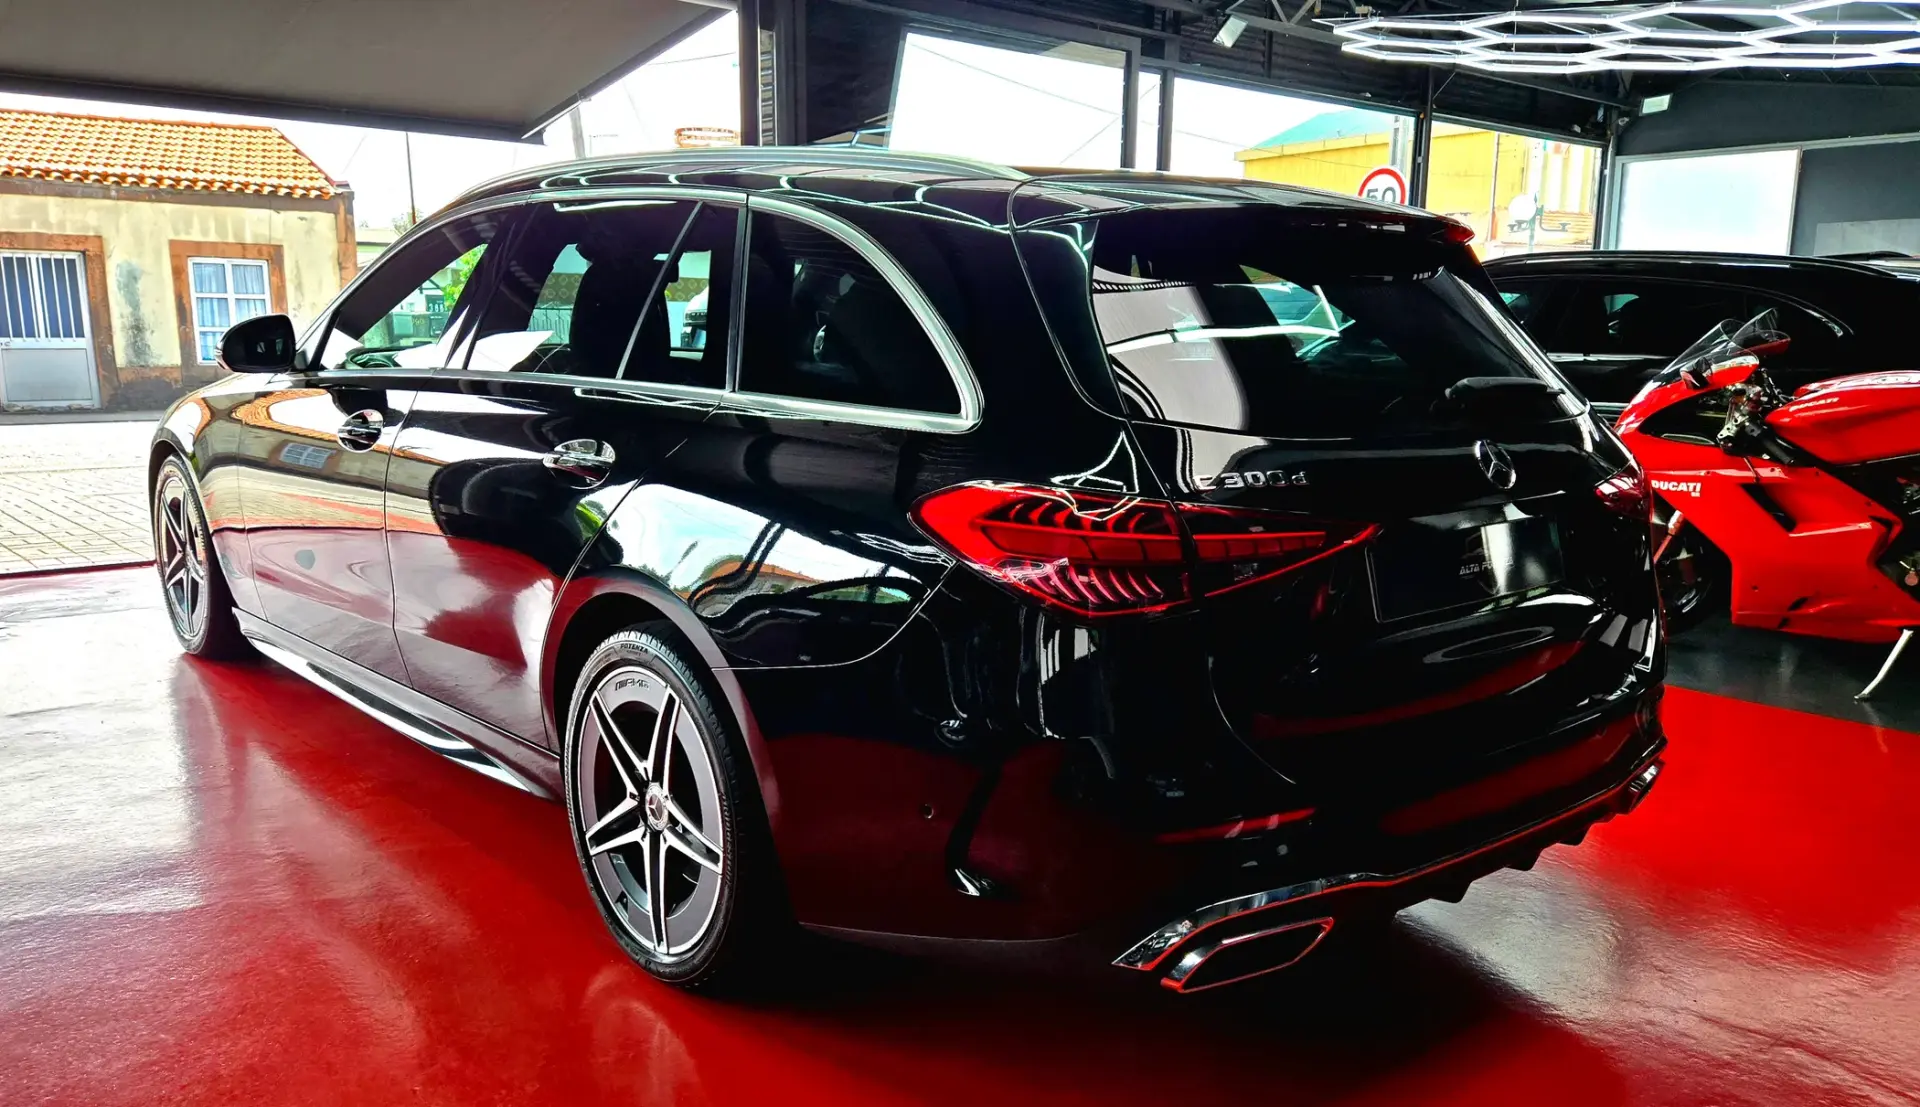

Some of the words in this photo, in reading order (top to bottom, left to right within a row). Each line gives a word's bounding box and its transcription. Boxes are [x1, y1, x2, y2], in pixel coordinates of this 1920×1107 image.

[1366, 187, 1396, 202] 50
[1788, 397, 1839, 412] DUCATI
[1651, 479, 1701, 492] DUCATI
[620, 643, 648, 653] POTENZA
